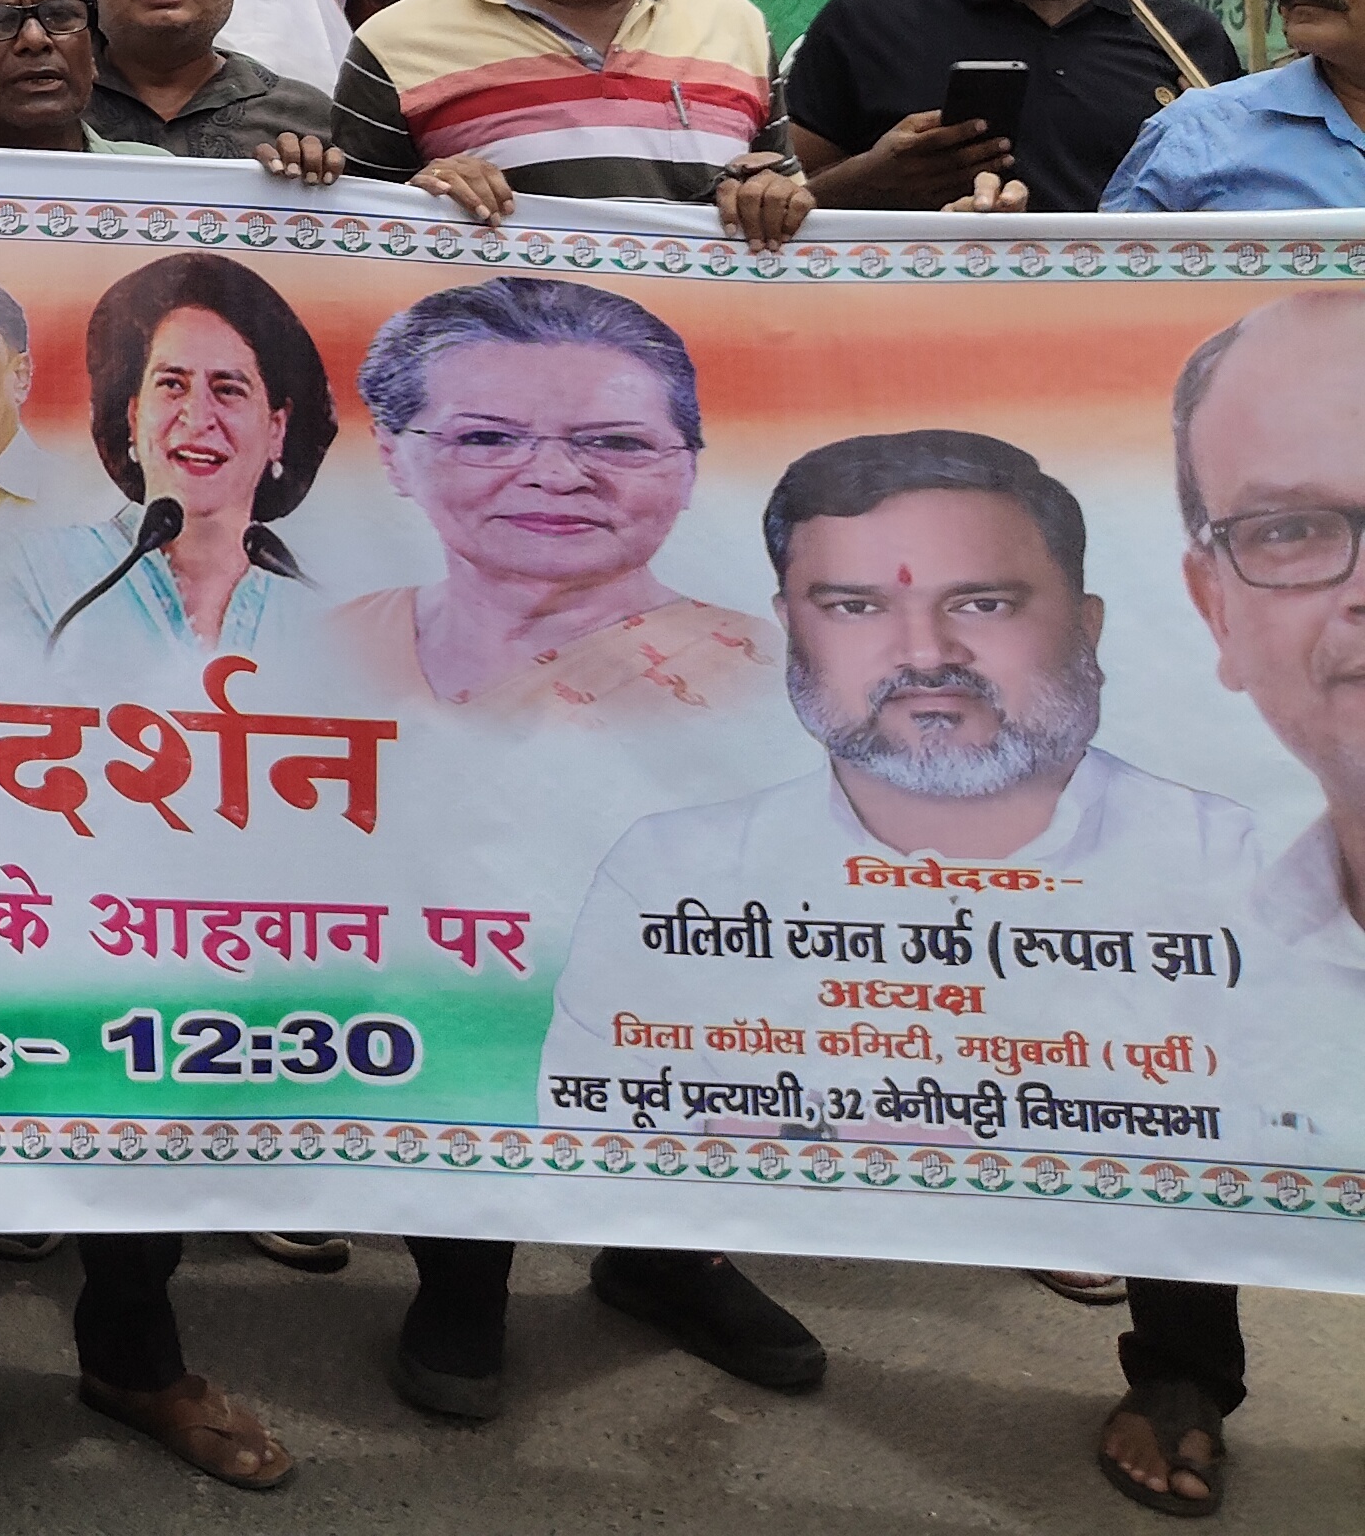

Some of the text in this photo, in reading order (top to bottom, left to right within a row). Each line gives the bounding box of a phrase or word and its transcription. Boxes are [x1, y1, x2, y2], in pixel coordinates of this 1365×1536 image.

[88, 892, 389, 973] आहवान
[422, 906, 531, 973] पर
[641, 897, 772, 960] नलिनी
[786, 902, 885, 964] रंजन
[899, 900, 973, 968] उर्फ
[818, 978, 986, 1015] अध्यक्ष
[107, 1015, 417, 1077] 12:30
[613, 1013, 694, 1052] जिला
[817, 1022, 944, 1065] कमिटी,
[957, 1030, 1089, 1078] मधुबनी
[550, 1066, 1222, 1141] सह पूर्व प्रत्याशी, 32 बेनीपट्टी विधानसभा
